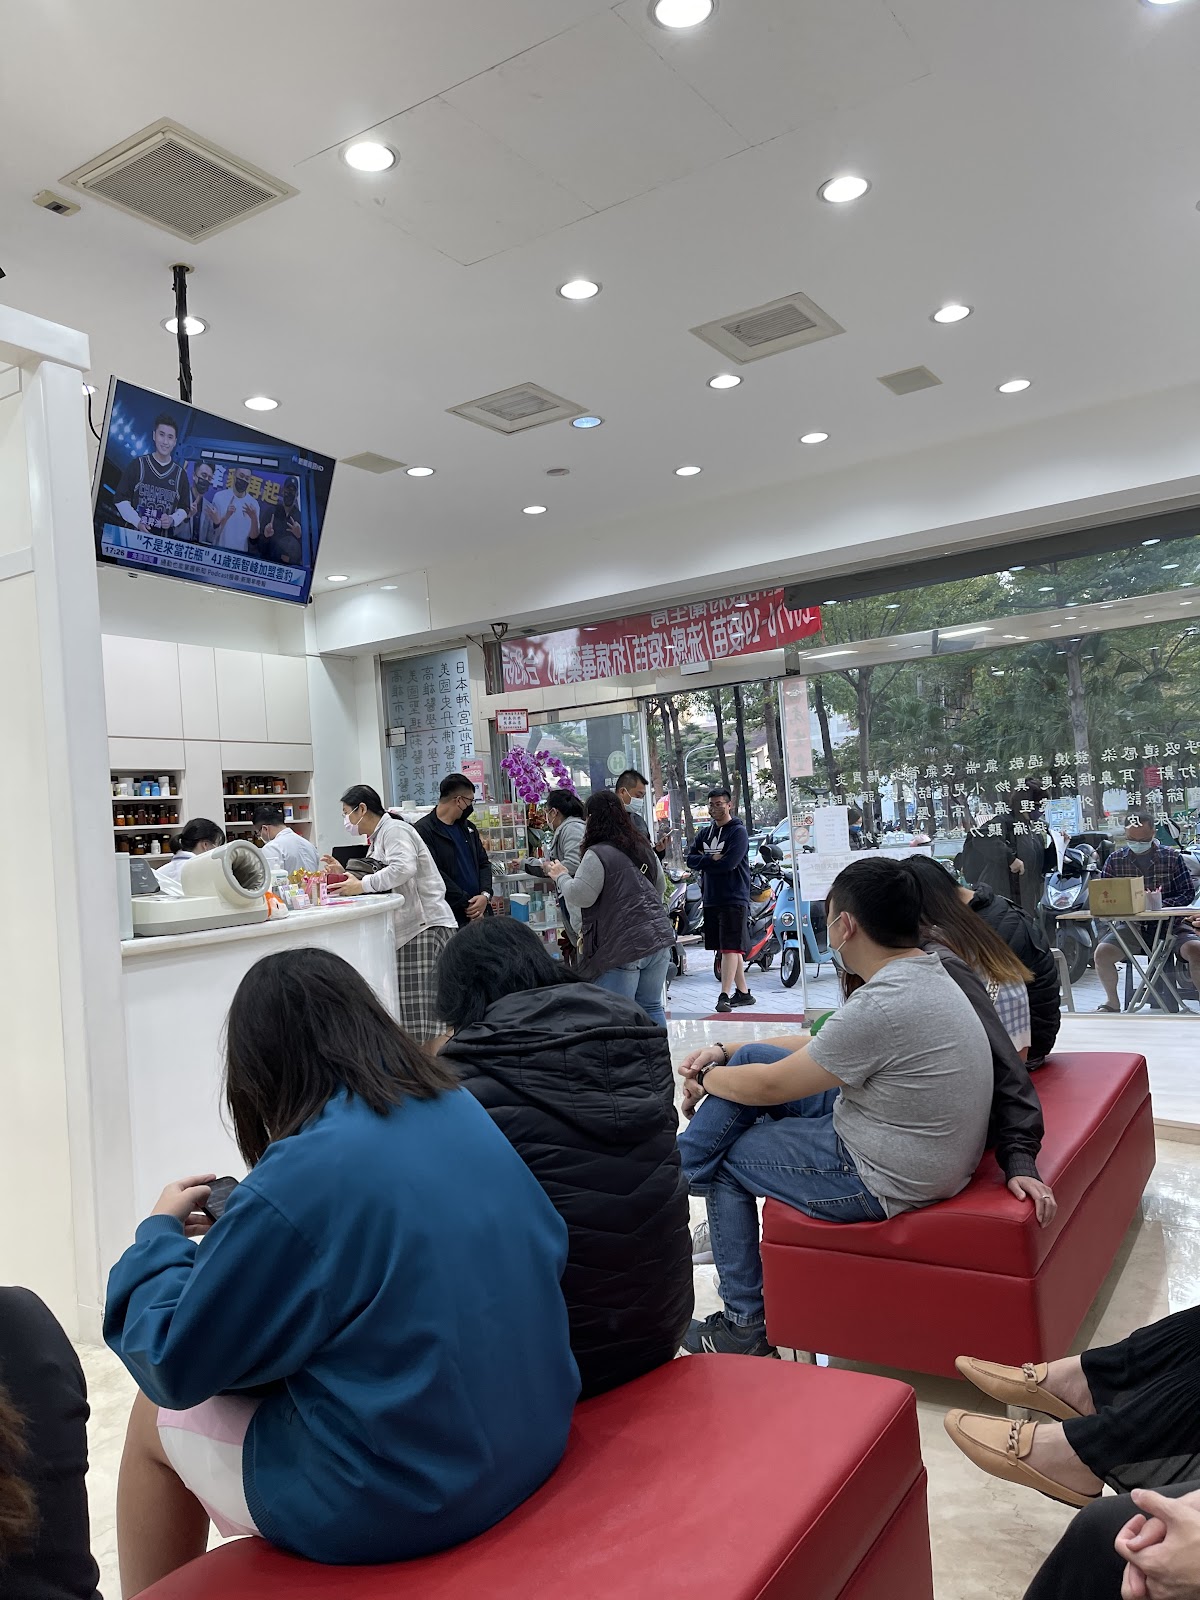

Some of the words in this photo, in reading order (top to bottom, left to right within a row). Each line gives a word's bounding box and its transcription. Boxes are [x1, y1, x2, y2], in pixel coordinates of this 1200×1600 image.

[212, 554, 294, 583] 41歲張智峰加盟雲豹
